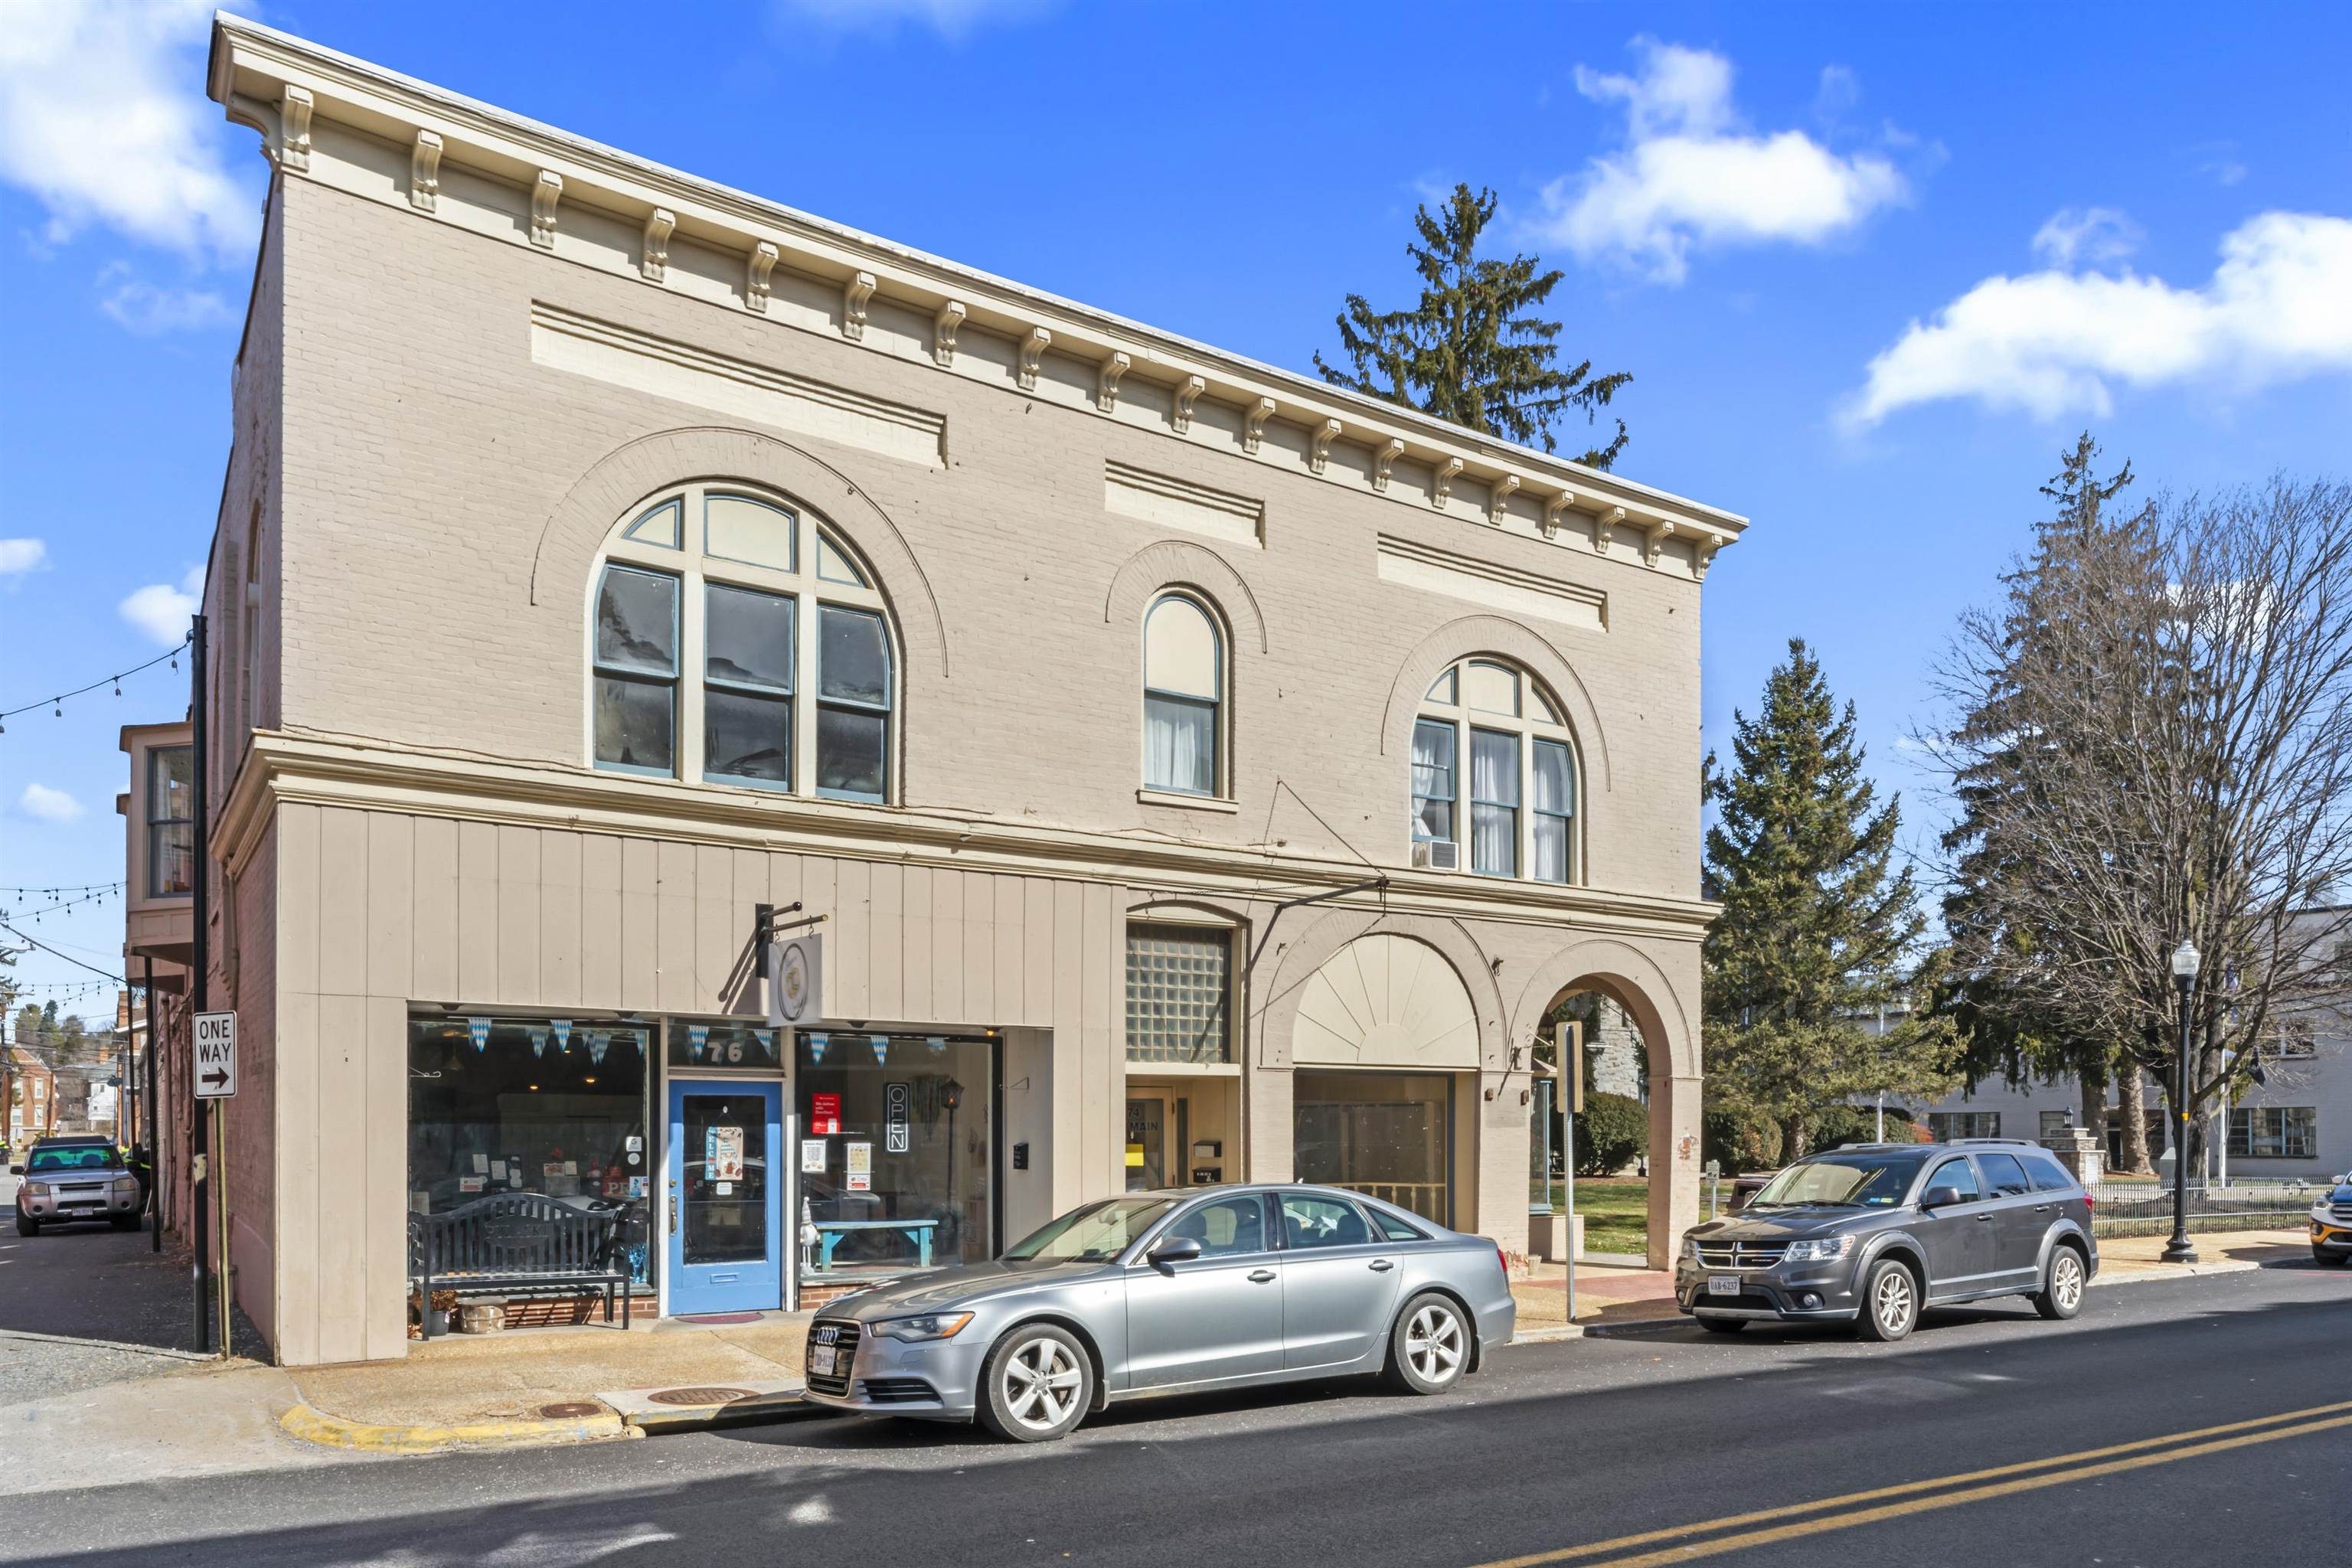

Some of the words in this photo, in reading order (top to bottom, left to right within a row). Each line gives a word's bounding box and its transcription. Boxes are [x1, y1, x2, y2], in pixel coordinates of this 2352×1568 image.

[200, 1019, 230, 1040] ONE
[199, 1042, 231, 1063] WAY
[707, 1041, 742, 1063] 76
[890, 1087, 905, 1148] OPEN
[1128, 1108, 1140, 1117] 74
[1130, 1121, 1158, 1131] MAIN
